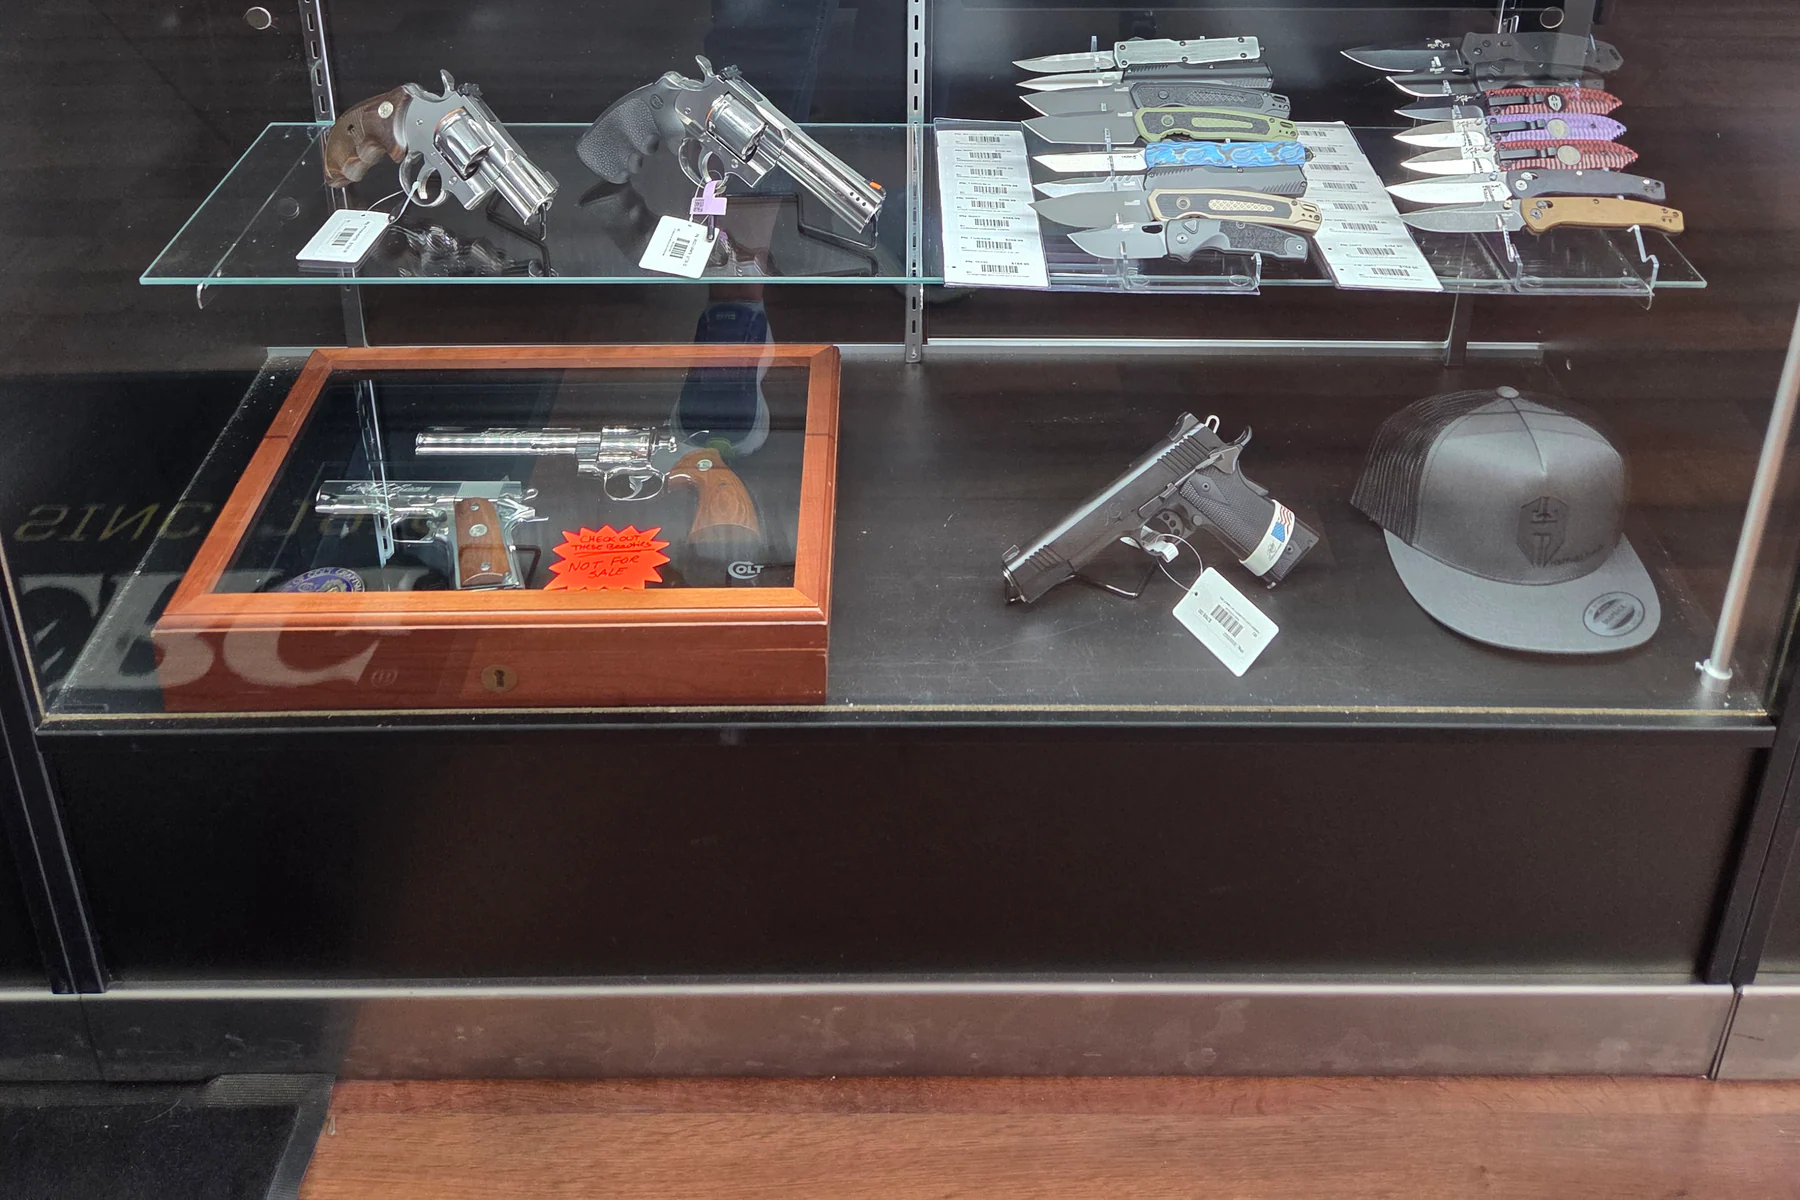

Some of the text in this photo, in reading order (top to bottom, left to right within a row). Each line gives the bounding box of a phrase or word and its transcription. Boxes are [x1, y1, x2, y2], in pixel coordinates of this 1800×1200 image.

[580, 535, 616, 543] CHECK
[568, 555, 640, 572] NOT FOR
[728, 561, 764, 579] COLT
[588, 567, 628, 579] SALE
